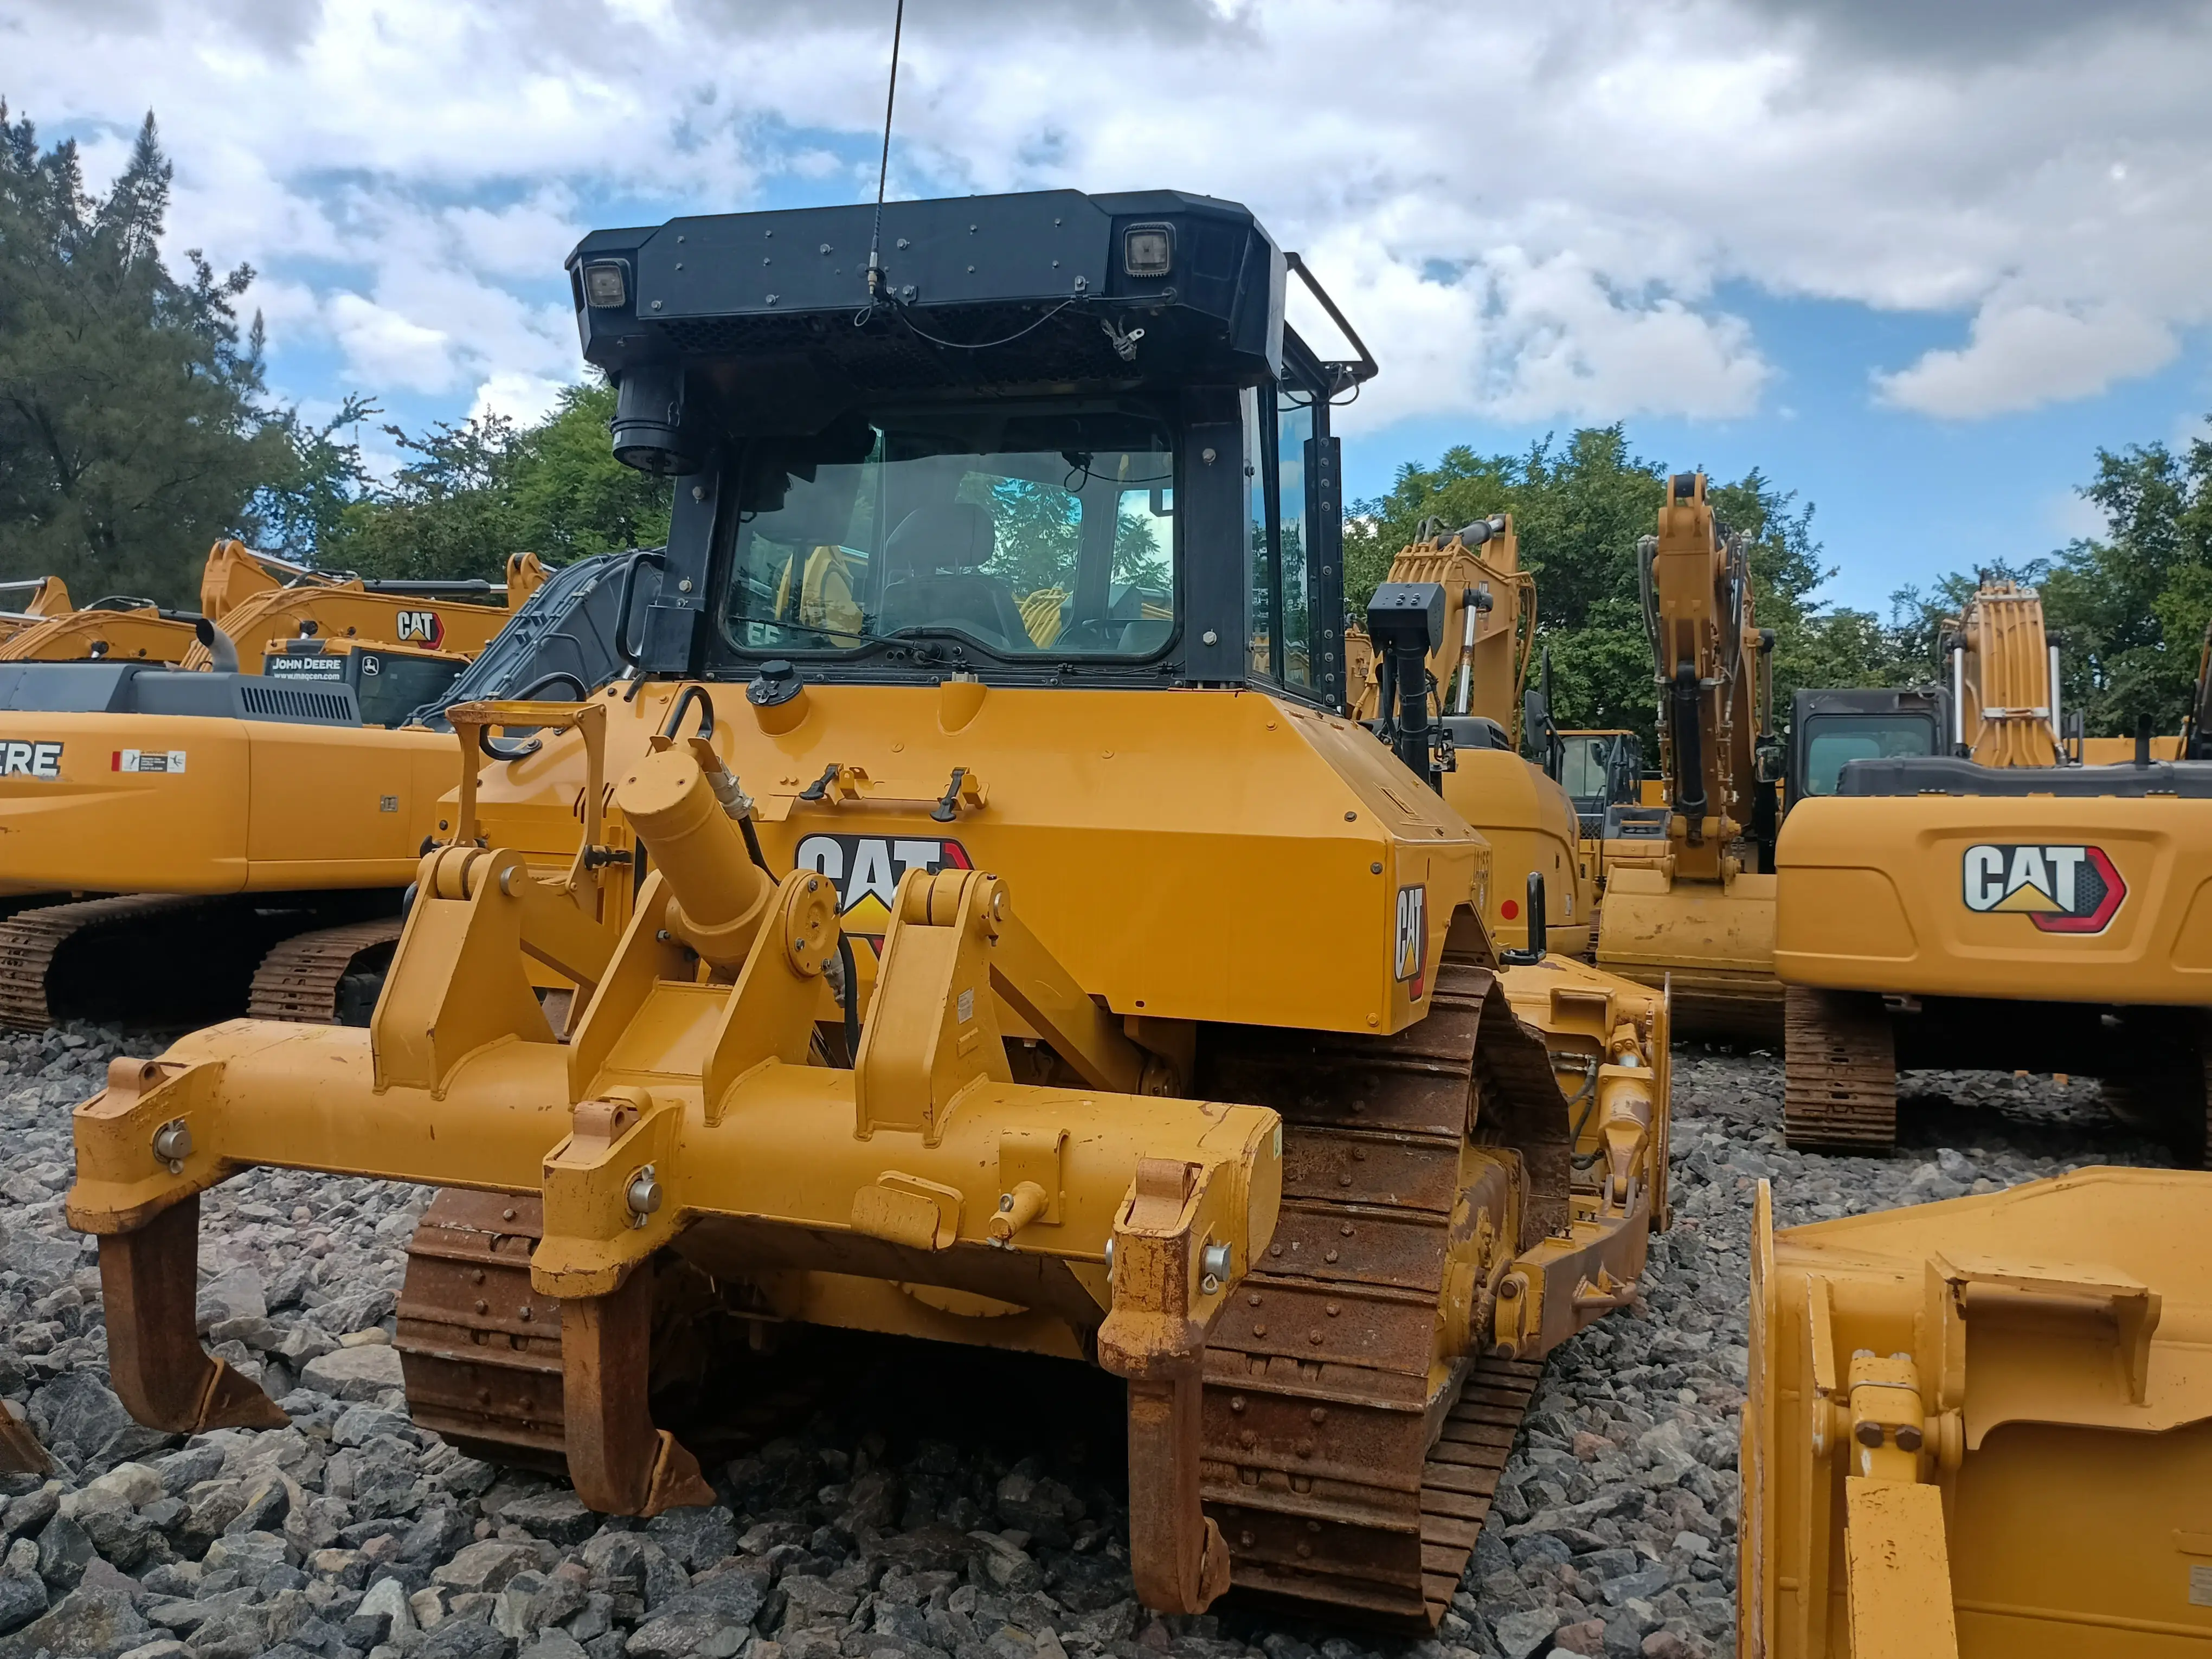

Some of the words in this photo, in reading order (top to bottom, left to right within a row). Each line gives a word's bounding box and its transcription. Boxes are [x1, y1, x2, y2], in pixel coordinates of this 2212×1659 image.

[397, 611, 434, 641] CAT
[273, 658, 303, 670] JOHN
[304, 658, 342, 670] DEERE
[0, 742, 61, 777] RE
[1964, 845, 2086, 913] CAT
[1394, 888, 1423, 979] CAT
